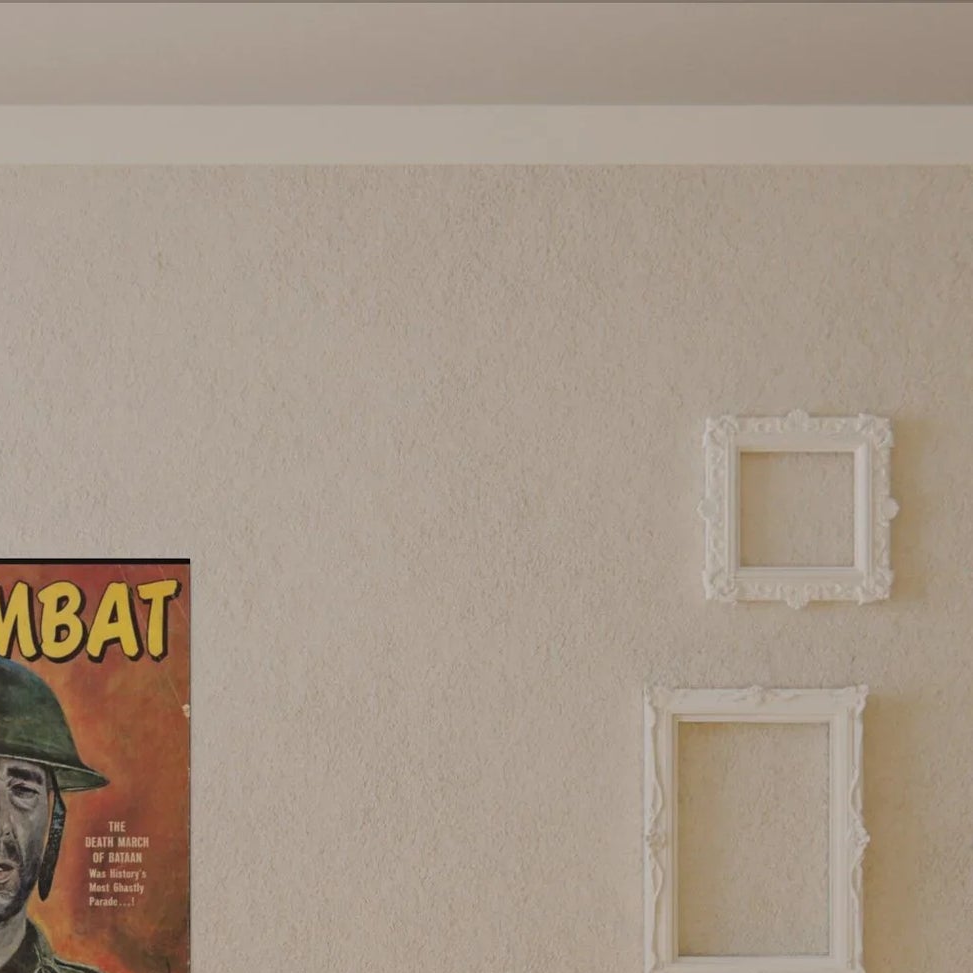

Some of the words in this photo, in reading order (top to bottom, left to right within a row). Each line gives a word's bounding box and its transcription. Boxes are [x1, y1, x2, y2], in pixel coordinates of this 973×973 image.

[108, 821, 126, 832] THE
[85, 836, 114, 848] DEATH
[118, 836, 149, 848] MARCH
[92, 852, 104, 863] OF
[108, 852, 142, 863] BATAAN
[89, 868, 106, 878] Was
[110, 868, 147, 880] History's
[89, 883, 109, 892] Most
[113, 882, 144, 894] Ghastly
